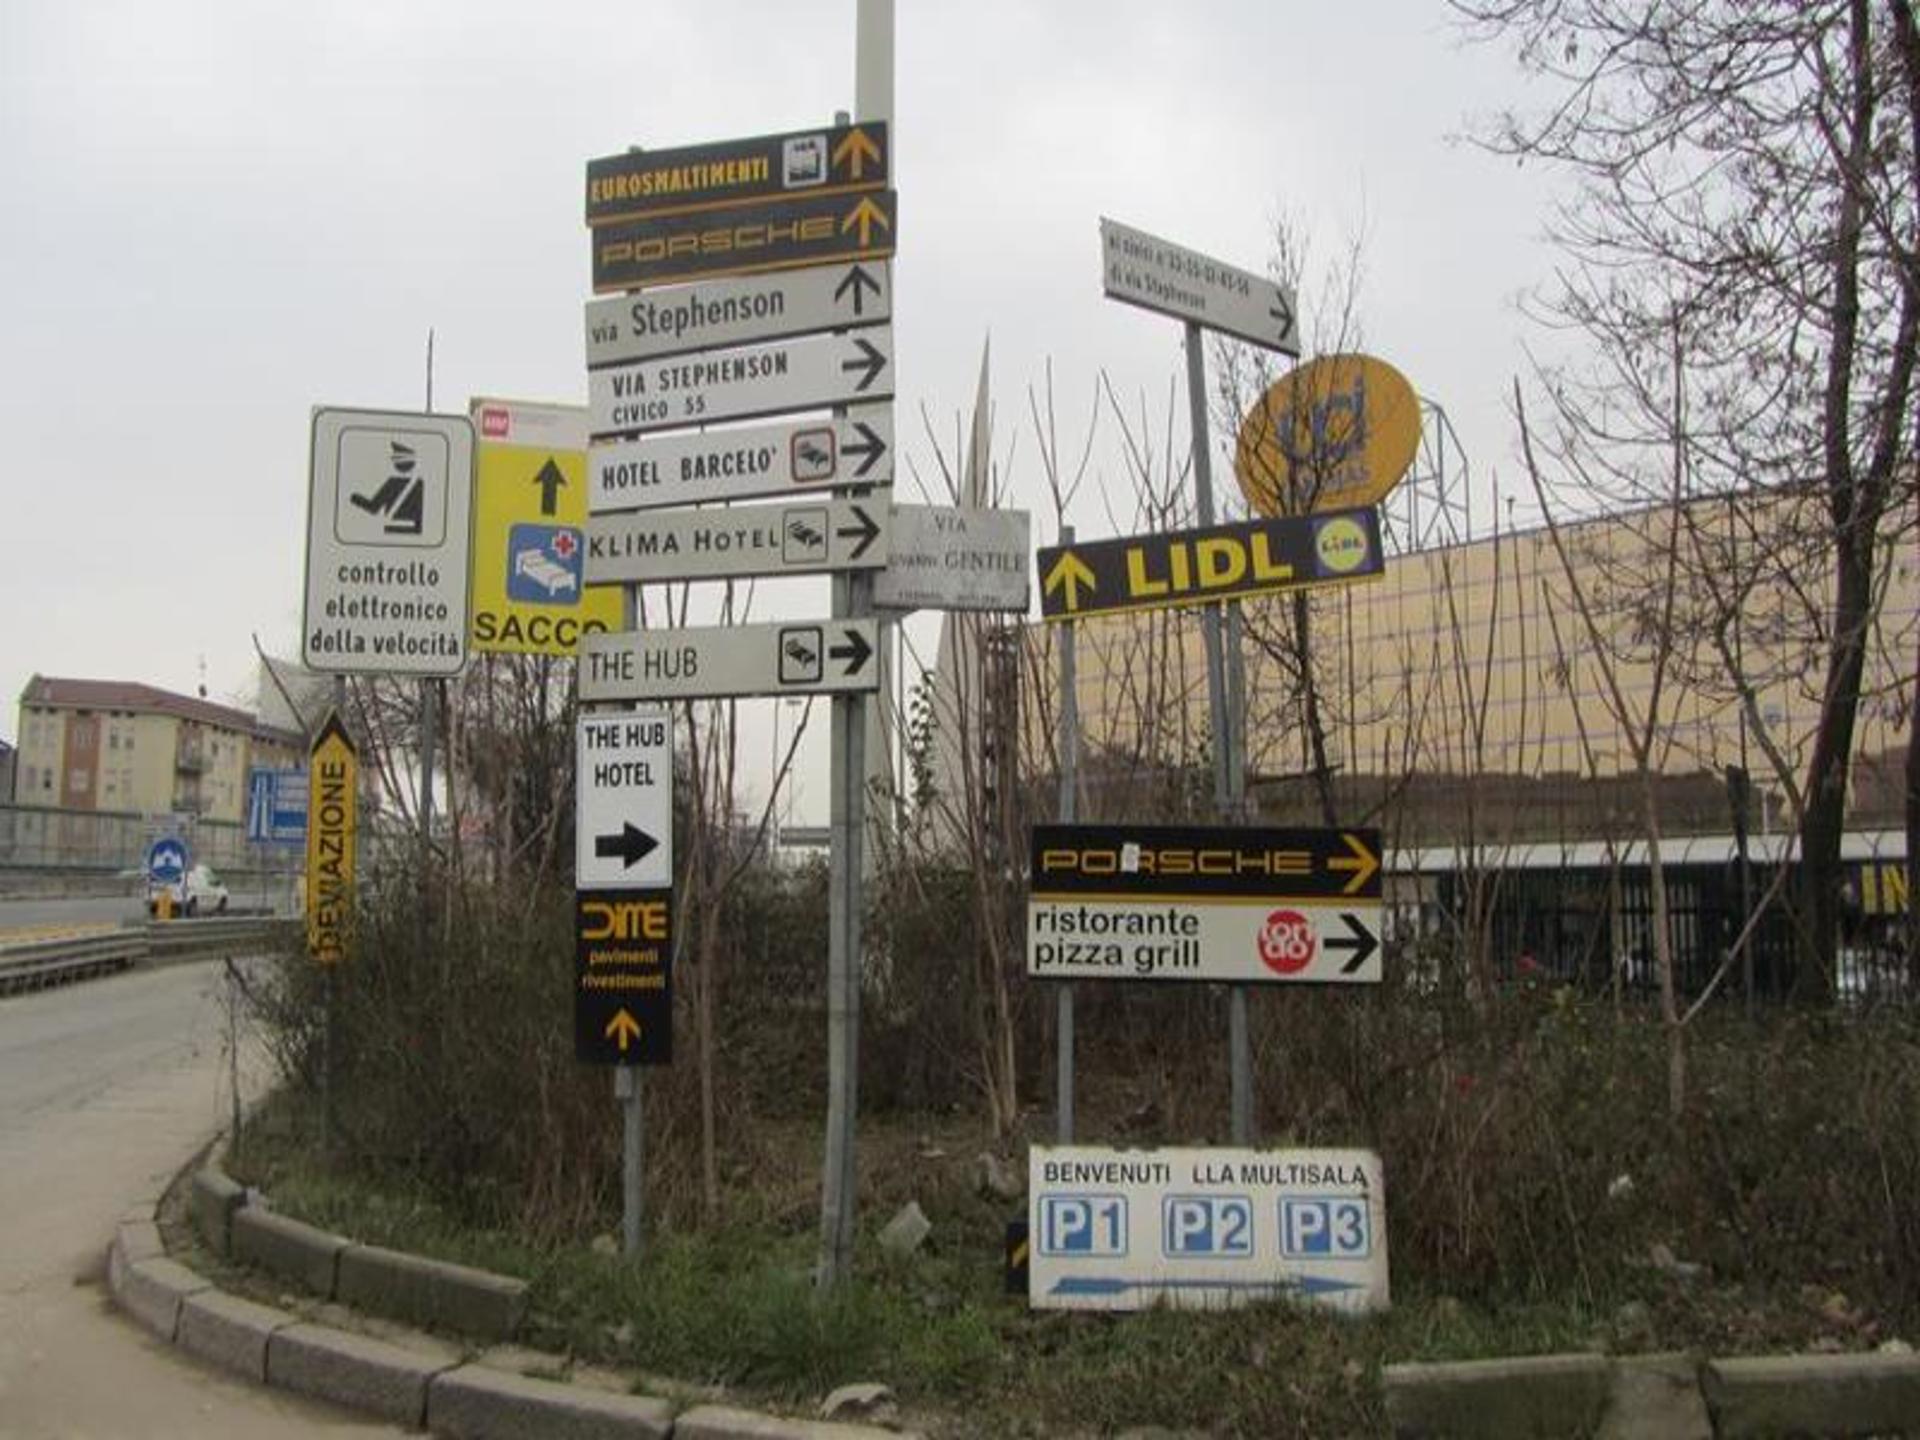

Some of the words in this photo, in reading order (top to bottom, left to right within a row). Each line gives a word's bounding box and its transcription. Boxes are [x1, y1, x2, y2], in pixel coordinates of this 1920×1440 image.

[602, 217, 835, 265] PORSCHE
[592, 323, 618, 344] via
[632, 290, 784, 338] Stephenson
[613, 373, 645, 398] VIA
[659, 351, 788, 391] STEPHENSON
[613, 400, 669, 425] CIVICO
[686, 395, 706, 415] 55
[602, 457, 661, 490] HOTEL
[935, 514, 966, 533] VIA
[589, 532, 679, 557] KLIMA
[338, 563, 440, 587] controllo
[945, 551, 1025, 573] GENTILE
[1127, 531, 1293, 597] LIDL
[326, 596, 448, 620] elettronico
[311, 628, 365, 653] della
[374, 633, 459, 657] velocità
[588, 651, 634, 681] THE
[645, 648, 698, 678] HUB
[585, 725, 620, 749] THE
[626, 722, 665, 747] HUB
[595, 762, 655, 787] HOTEL
[1034, 907, 1200, 936] ristorante
[1034, 940, 1124, 971] pizza
[1134, 939, 1200, 972] grill
[1044, 1161, 1171, 1184] BENVENUTI
[1241, 1163, 1368, 1187] MULTISALA
